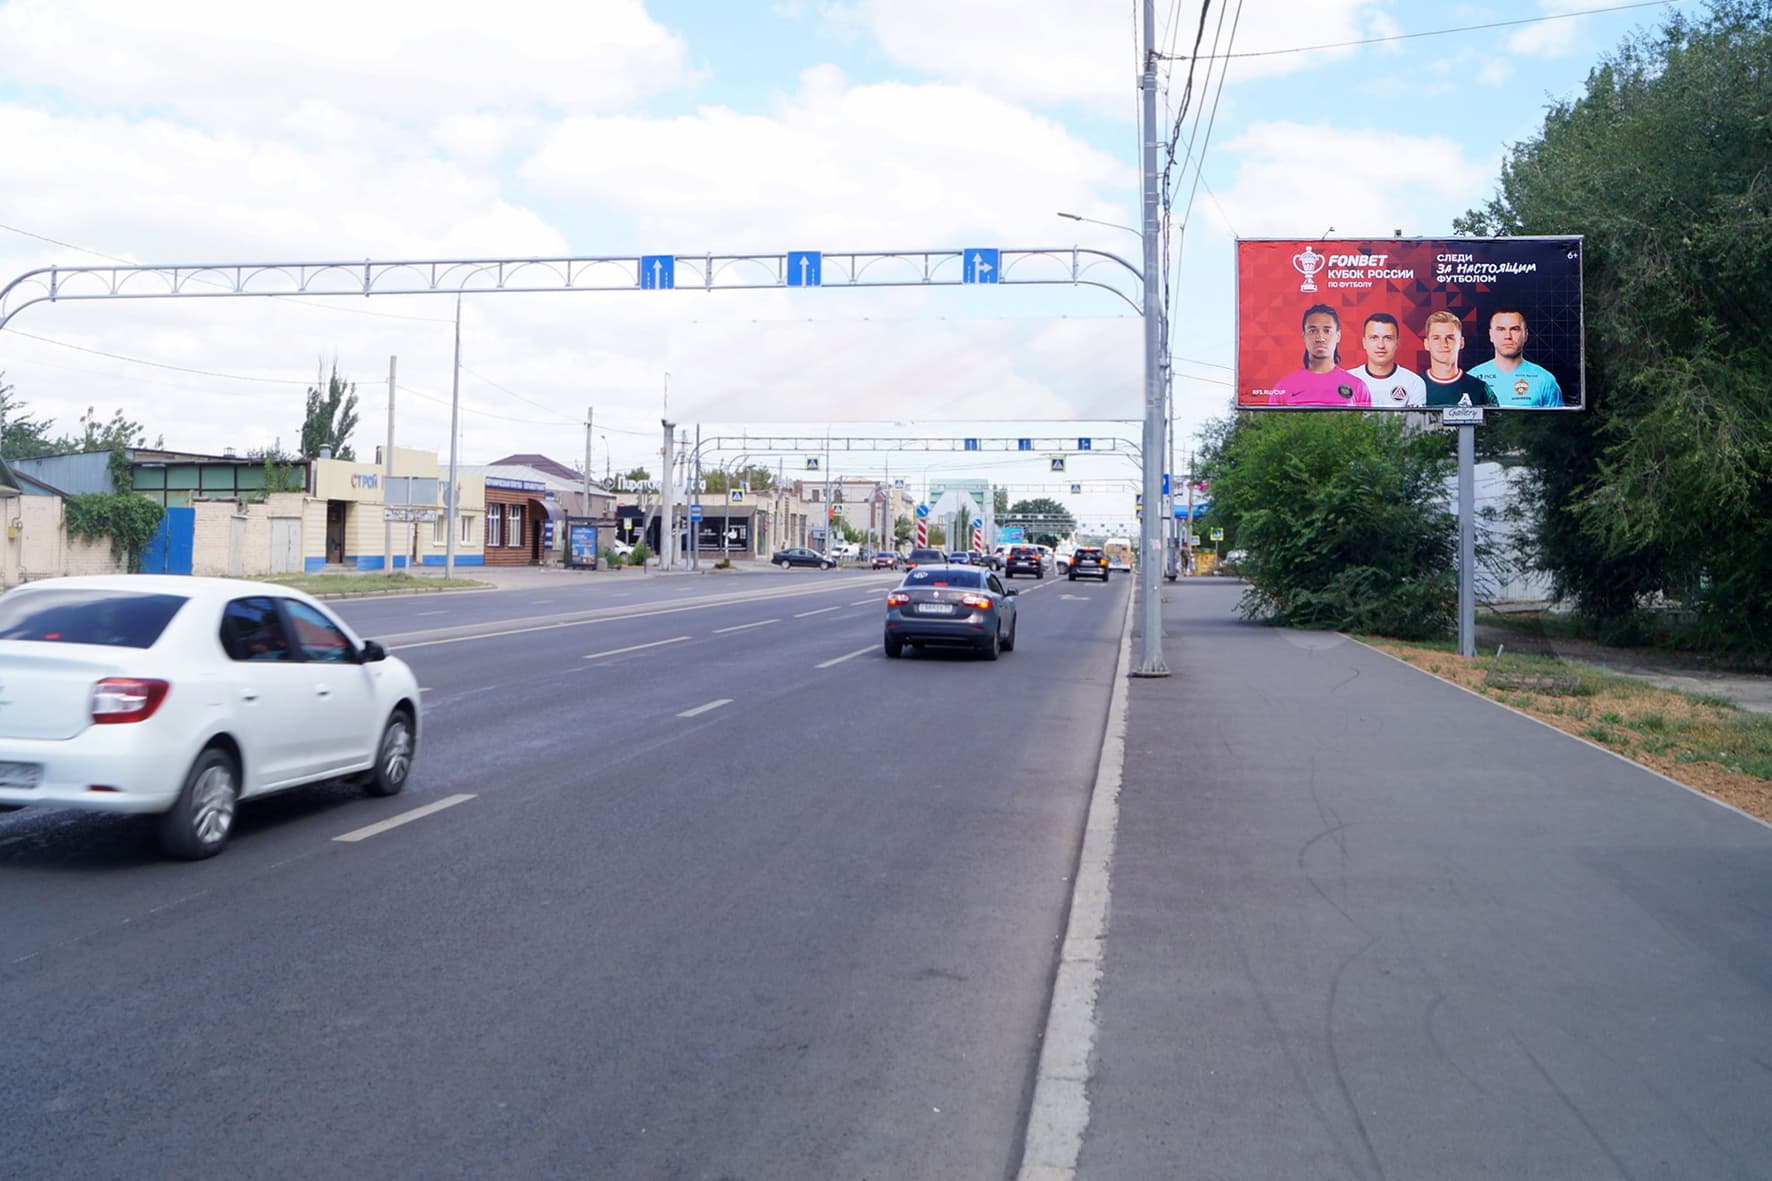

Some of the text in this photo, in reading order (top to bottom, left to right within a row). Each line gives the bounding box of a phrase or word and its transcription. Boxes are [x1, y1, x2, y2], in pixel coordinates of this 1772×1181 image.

[1436, 254, 1473, 263] СЛЕДИ
[1567, 251, 1578, 259] 6+
[1328, 255, 1388, 267] FONBET
[1436, 262, 1537, 275] ЗА НАСТОЯЩИМ
[1328, 269, 1414, 279] КУБОК РОССИИ
[1436, 275, 1497, 283] ФУТБОЛОМ
